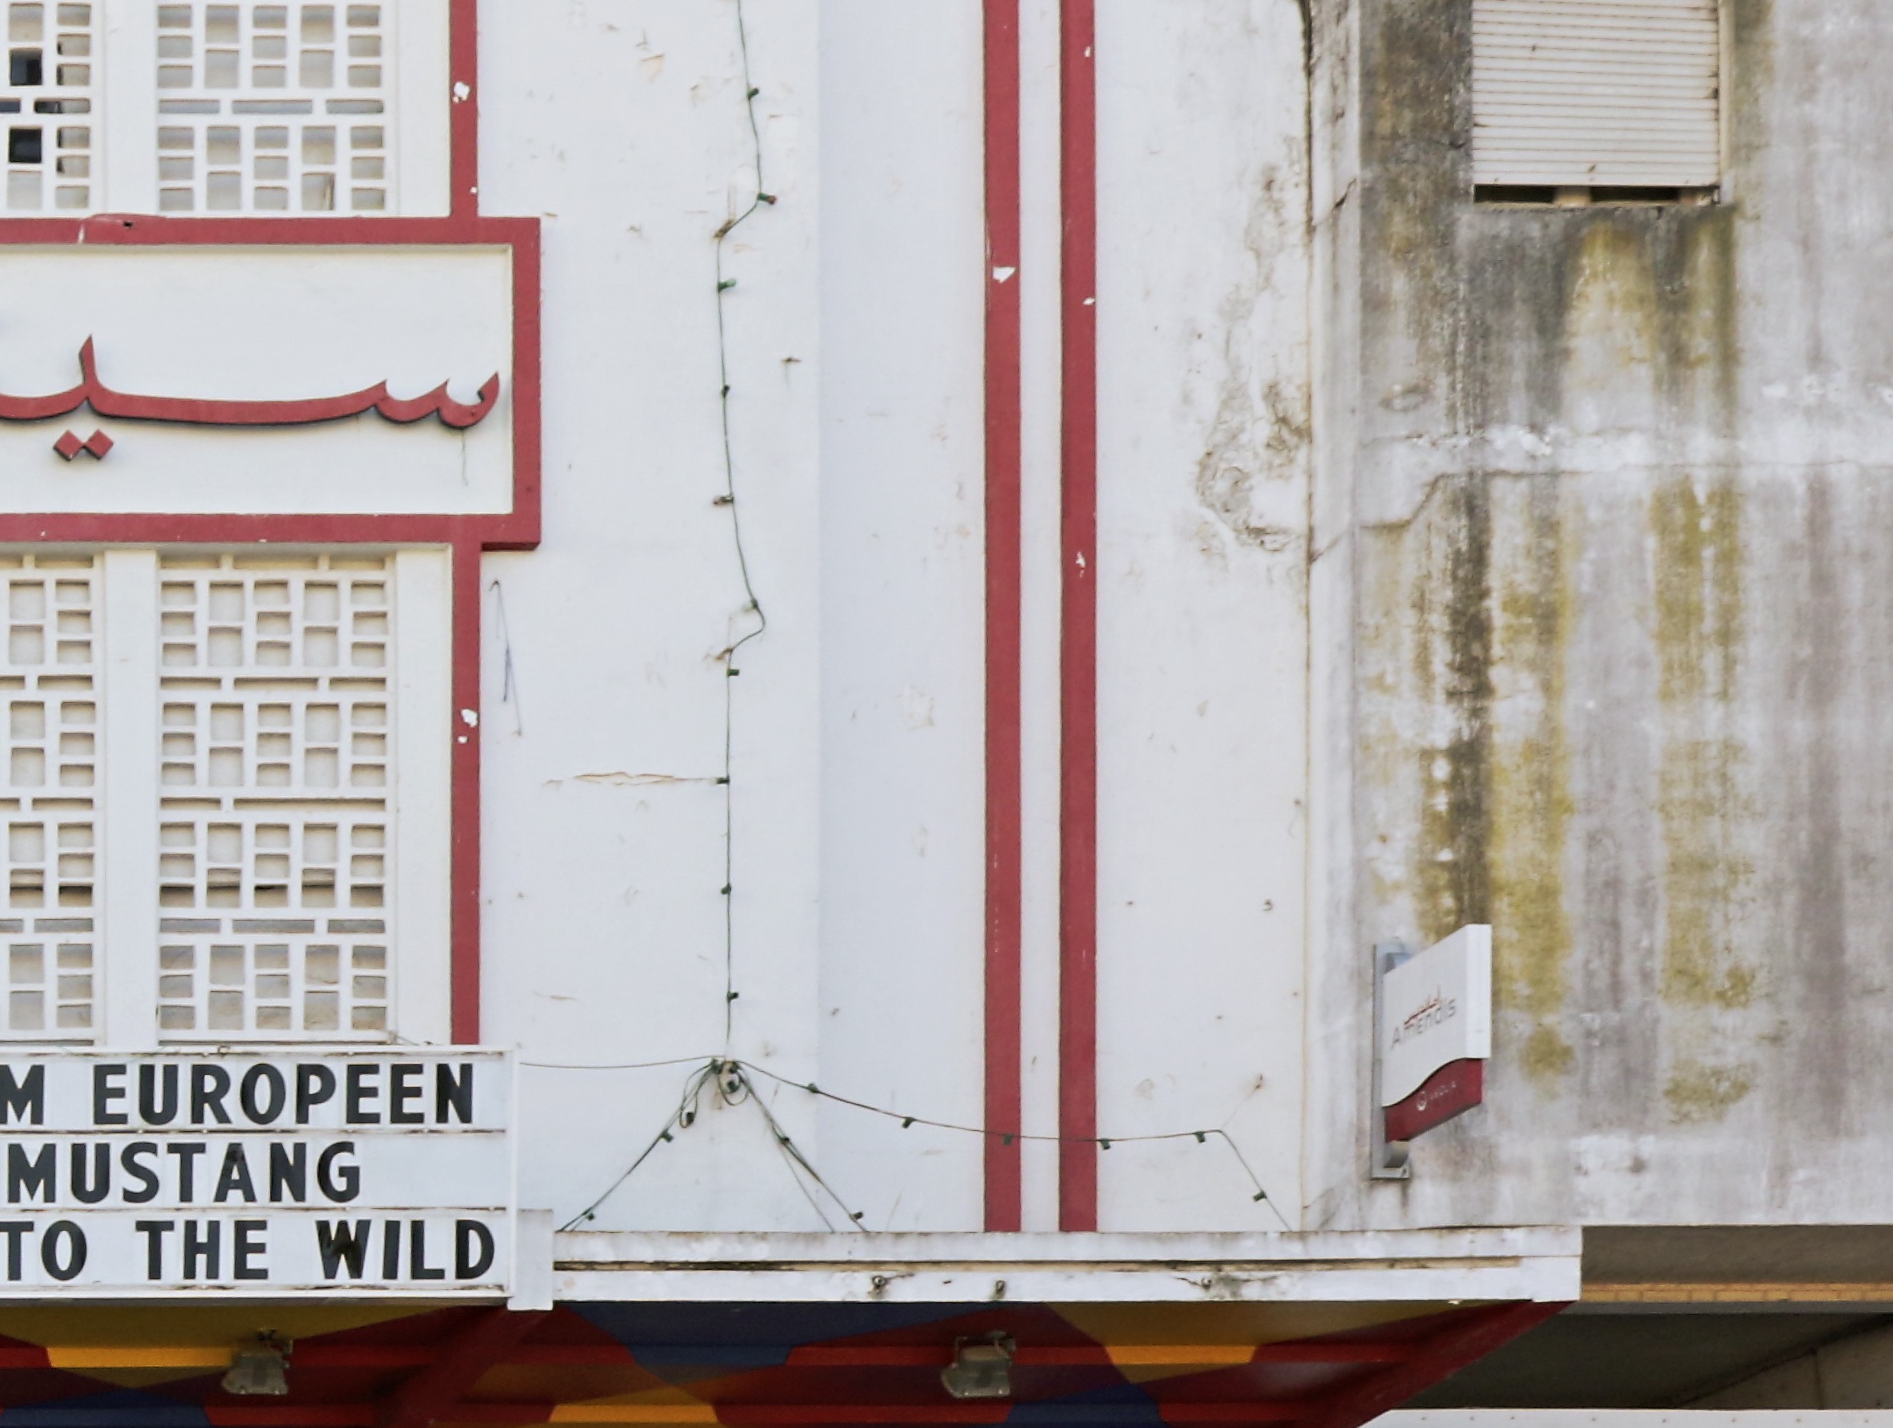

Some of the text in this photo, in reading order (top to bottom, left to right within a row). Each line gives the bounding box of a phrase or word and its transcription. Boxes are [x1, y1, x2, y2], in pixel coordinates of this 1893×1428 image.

[91, 1061, 474, 1127] EUROPEEN
[7, 1139, 361, 1204] MUSTANG
[134, 1218, 268, 1282] THE
[315, 1217, 496, 1282] WILD
